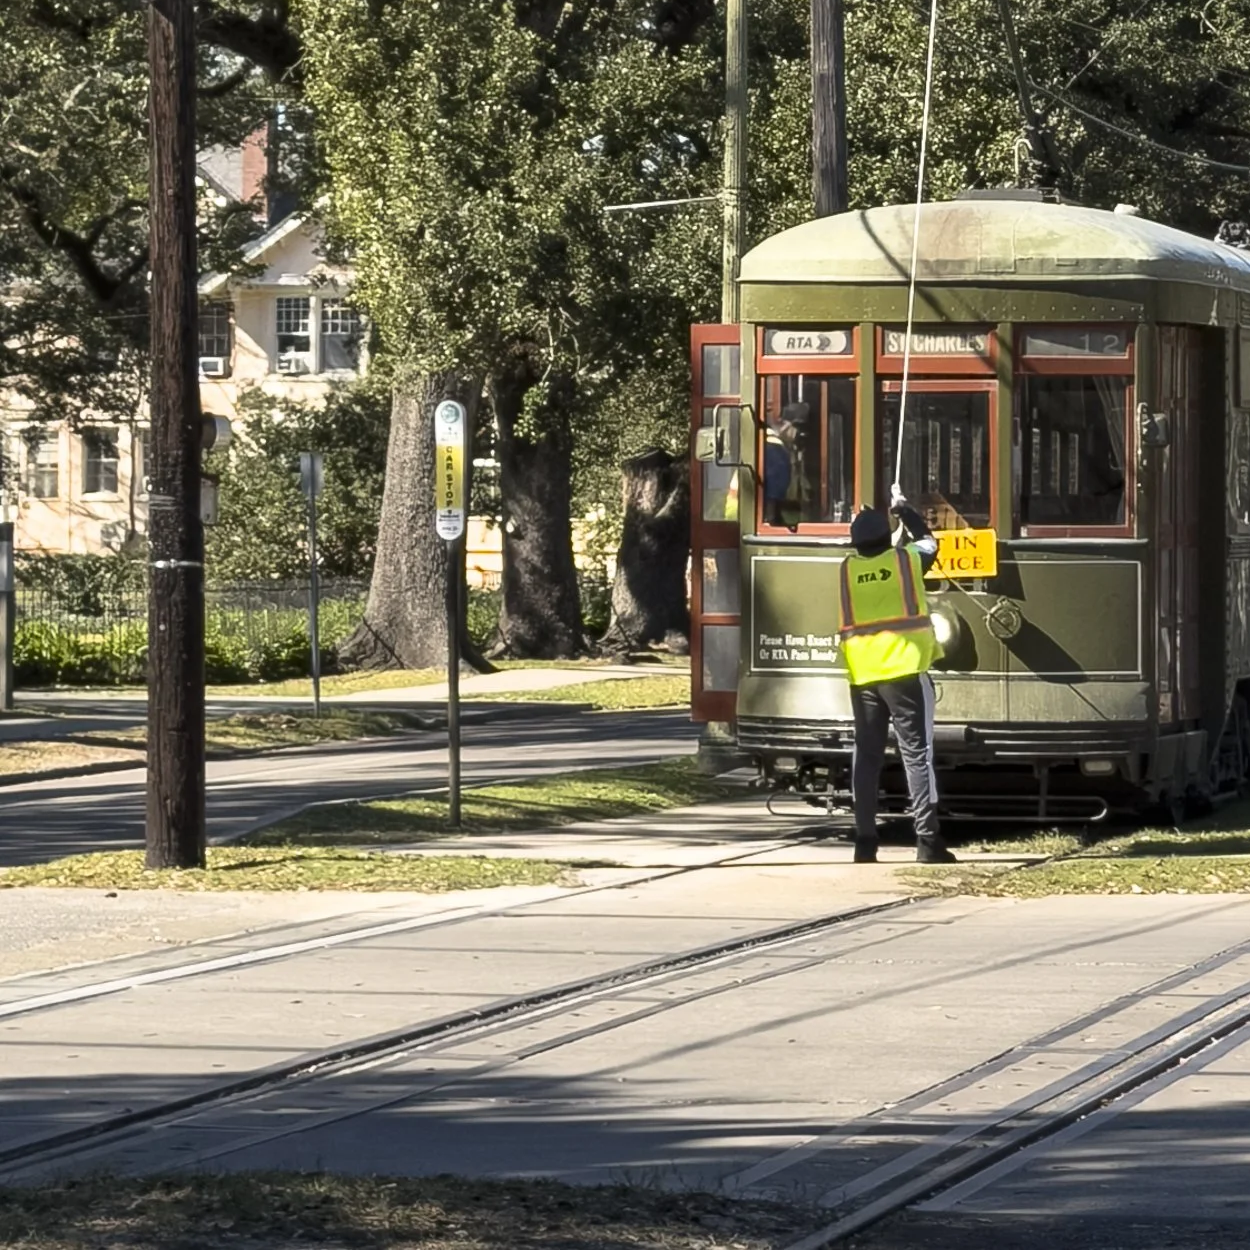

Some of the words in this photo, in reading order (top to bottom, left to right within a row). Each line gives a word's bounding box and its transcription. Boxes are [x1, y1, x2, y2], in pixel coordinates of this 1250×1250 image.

[786, 336, 813, 350] RTA
[911, 333, 985, 354] CHARLES
[445, 445, 454, 470] CAR
[445, 474, 454, 507] STOP
[955, 535, 978, 551] IN
[935, 555, 985, 571] VICE
[857, 572, 877, 584] RTA
